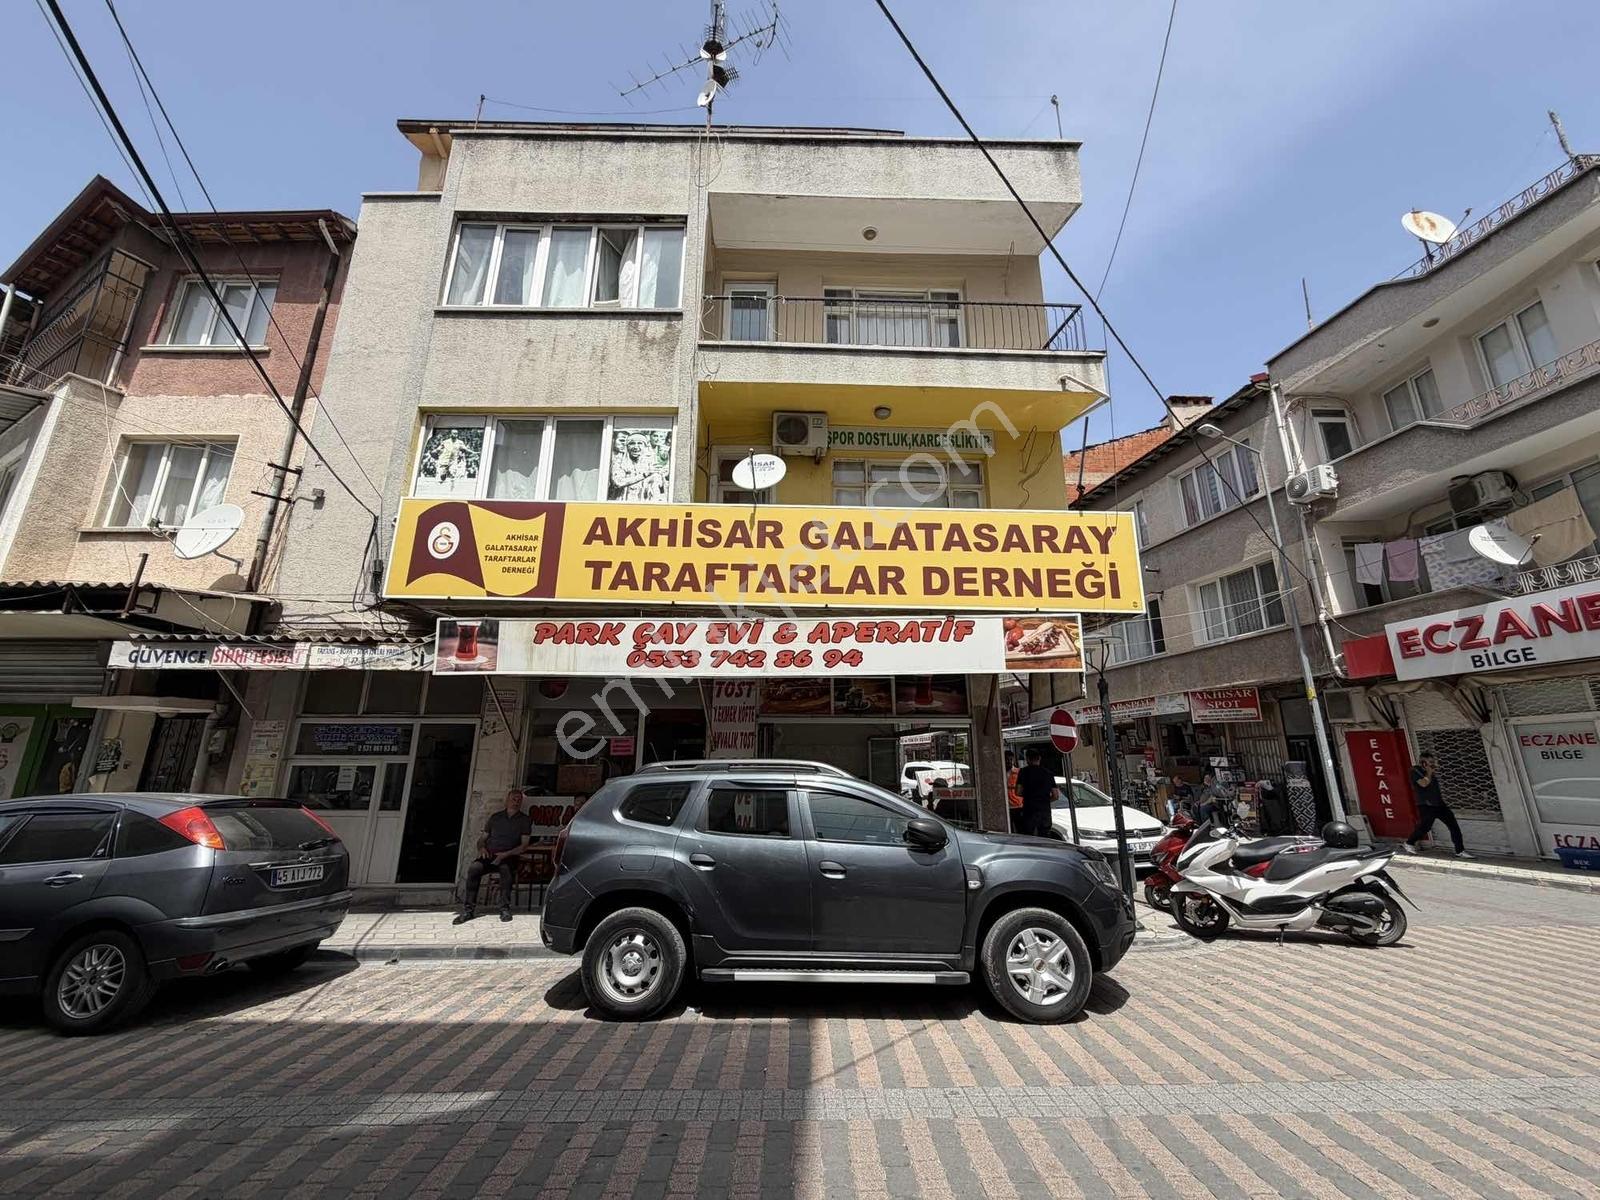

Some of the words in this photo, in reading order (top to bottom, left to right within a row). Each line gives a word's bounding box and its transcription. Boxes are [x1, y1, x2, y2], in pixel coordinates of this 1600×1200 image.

[506, 533, 539, 542] AKHİSAR
[583, 511, 785, 549] AKHİSAR
[799, 520, 1117, 554] GALATASARAY
[485, 544, 537, 552] GALATASARAY
[484, 555, 536, 563] TARAFTARLAR
[502, 566, 535, 574] DERNEĞİ
[584, 560, 907, 596] TARAFTARLAR
[923, 561, 1121, 599] DERNEĞİ
[533, 621, 626, 646] PARK
[633, 621, 697, 650] ÇAY
[705, 617, 765, 645] EVİ
[773, 623, 798, 645] &
[807, 615, 975, 645] APERATİF
[1396, 592, 1600, 660] ECZANE
[128, 645, 208, 664] GÜVENCE
[626, 649, 702, 669] 0553
[709, 648, 767, 668] 742
[773, 648, 812, 668] 86
[822, 648, 863, 668] 94
[1470, 646, 1537, 669] BİLGE
[715, 680, 756, 699] TOST
[1207, 699, 1241, 709] SPOT
[739, 731, 755, 750] TOST
[1520, 732, 1597, 747] ECZANE
[1541, 748, 1584, 760] BİLGE
[1368, 738, 1395, 819] ECZANE
[277, 872, 288, 882] 45
[308, 867, 322, 879] 772
